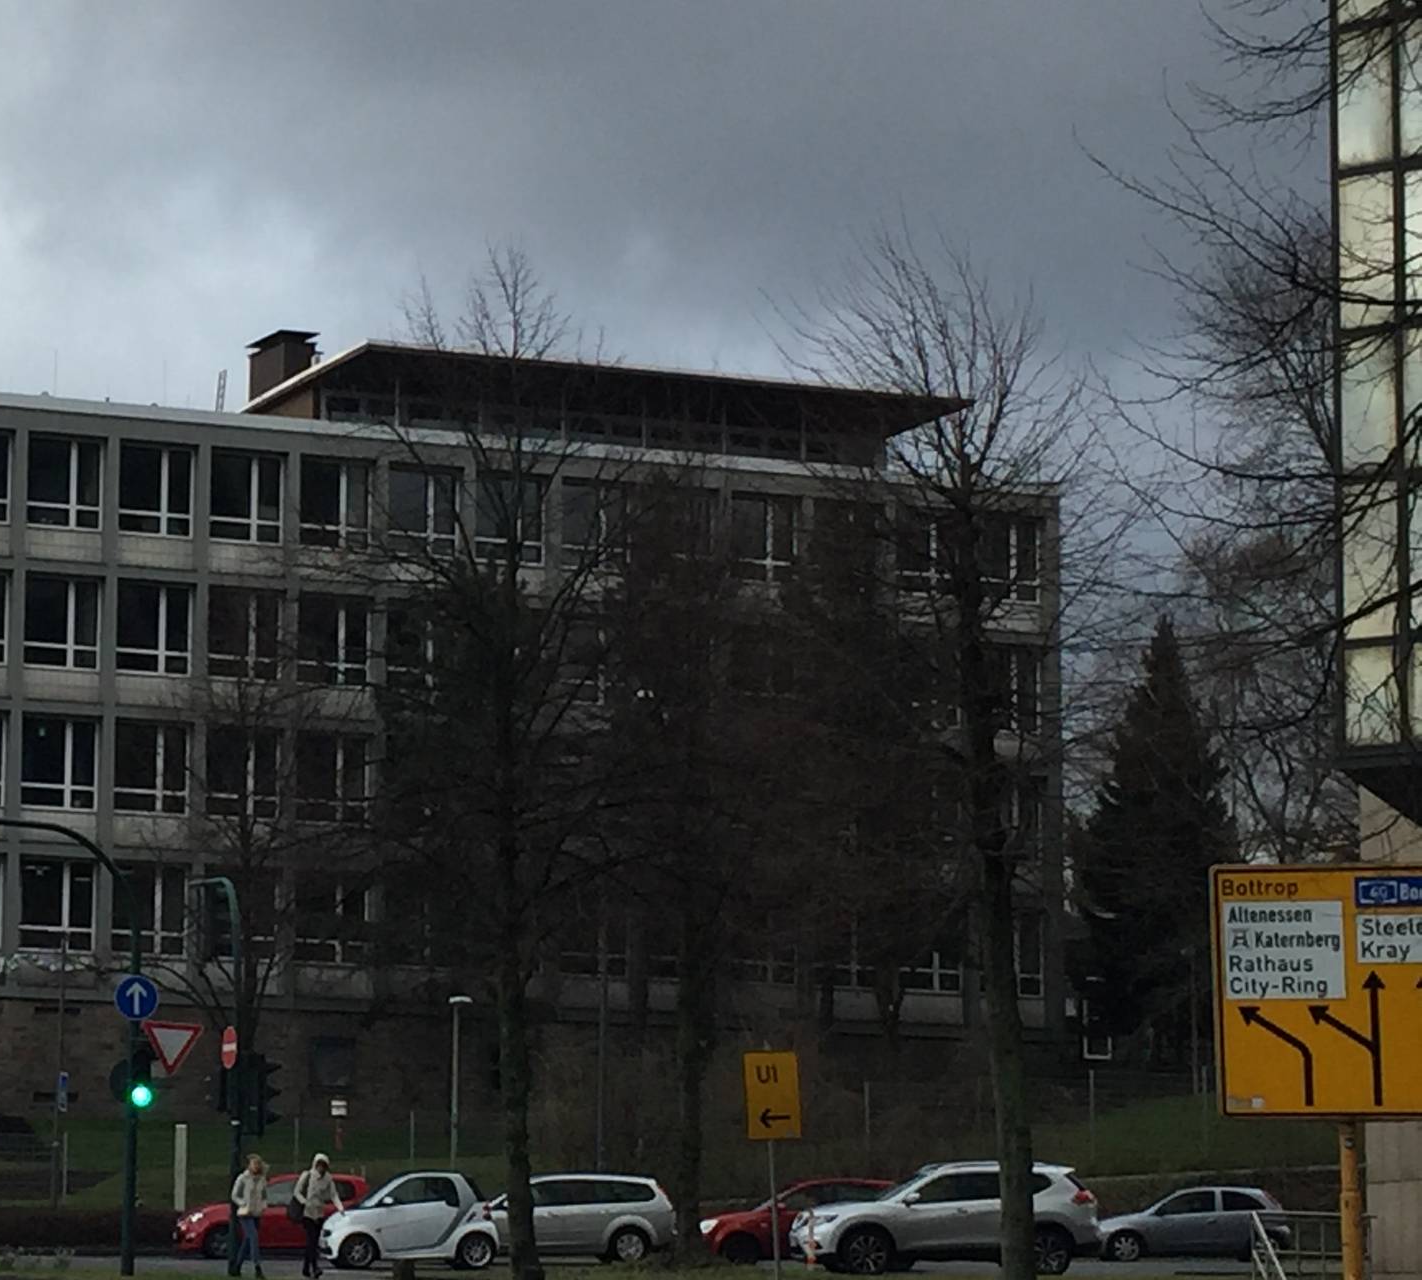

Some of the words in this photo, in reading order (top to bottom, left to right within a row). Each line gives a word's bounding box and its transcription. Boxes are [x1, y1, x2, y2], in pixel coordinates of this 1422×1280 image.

[1221, 879, 1299, 898] Bottrop
[1399, 882, 1422, 900] Bo
[1227, 906, 1313, 923] Altenessen
[1254, 930, 1340, 952] Katernberg
[1361, 940, 1410, 962] Kray
[1228, 954, 1314, 973] Rathaus
[1229, 976, 1328, 999] City-Ring
[755, 1065, 778, 1084] U1
